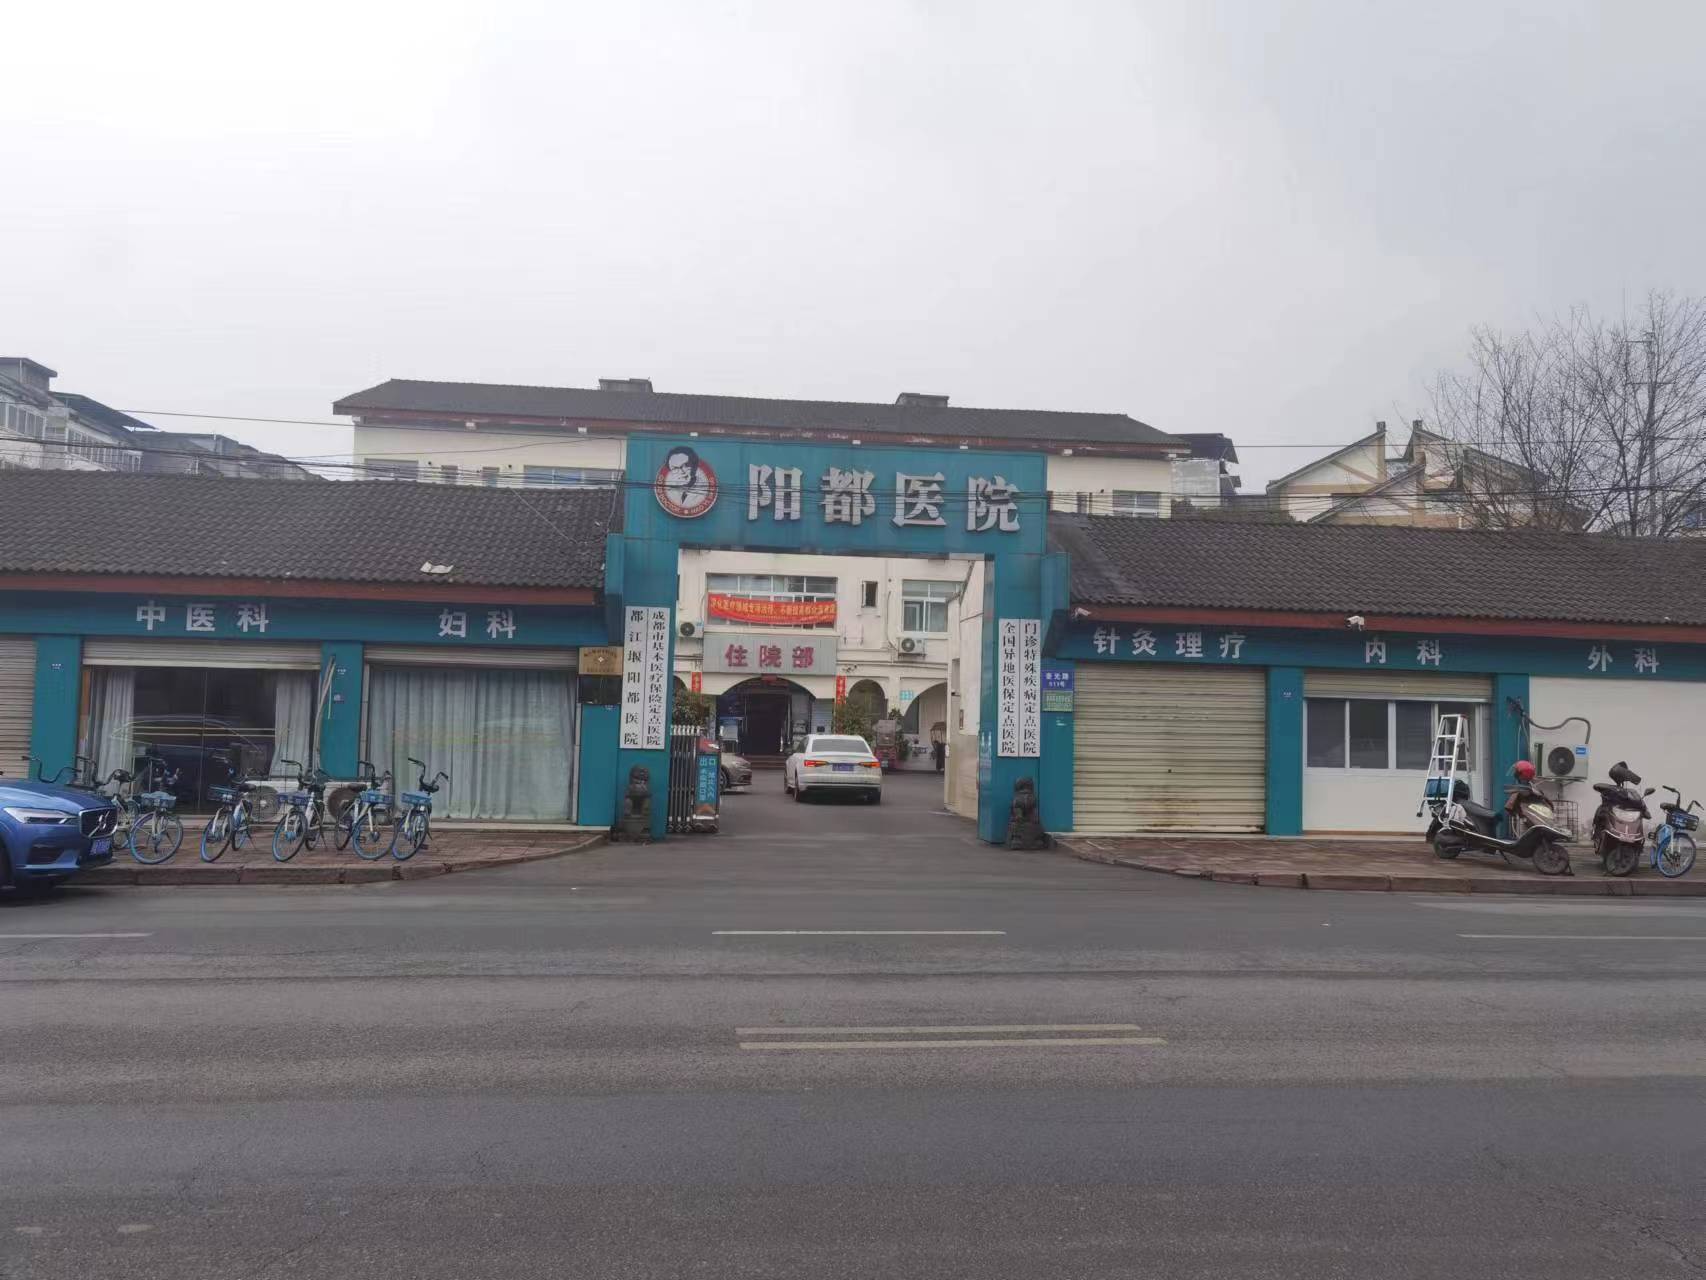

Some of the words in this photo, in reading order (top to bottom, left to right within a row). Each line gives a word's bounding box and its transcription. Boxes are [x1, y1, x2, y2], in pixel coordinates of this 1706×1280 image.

[748, 463, 1021, 531] 阳都医院
[136, 600, 269, 632] 中医科
[439, 608, 517, 638] 妇科
[725, 643, 816, 668] 住院部
[1093, 626, 1247, 659] 针灸理疗
[1365, 637, 1443, 666] 内科
[1588, 644, 1661, 673] 外科
[623, 609, 643, 746] 都江堰阳都医院
[646, 610, 665, 747] 成都市基本医疗保险定点医院
[1001, 622, 1016, 754] 全国异地医保定点医院
[1023, 622, 1038, 754] 门诊特殊疾病定点医院
